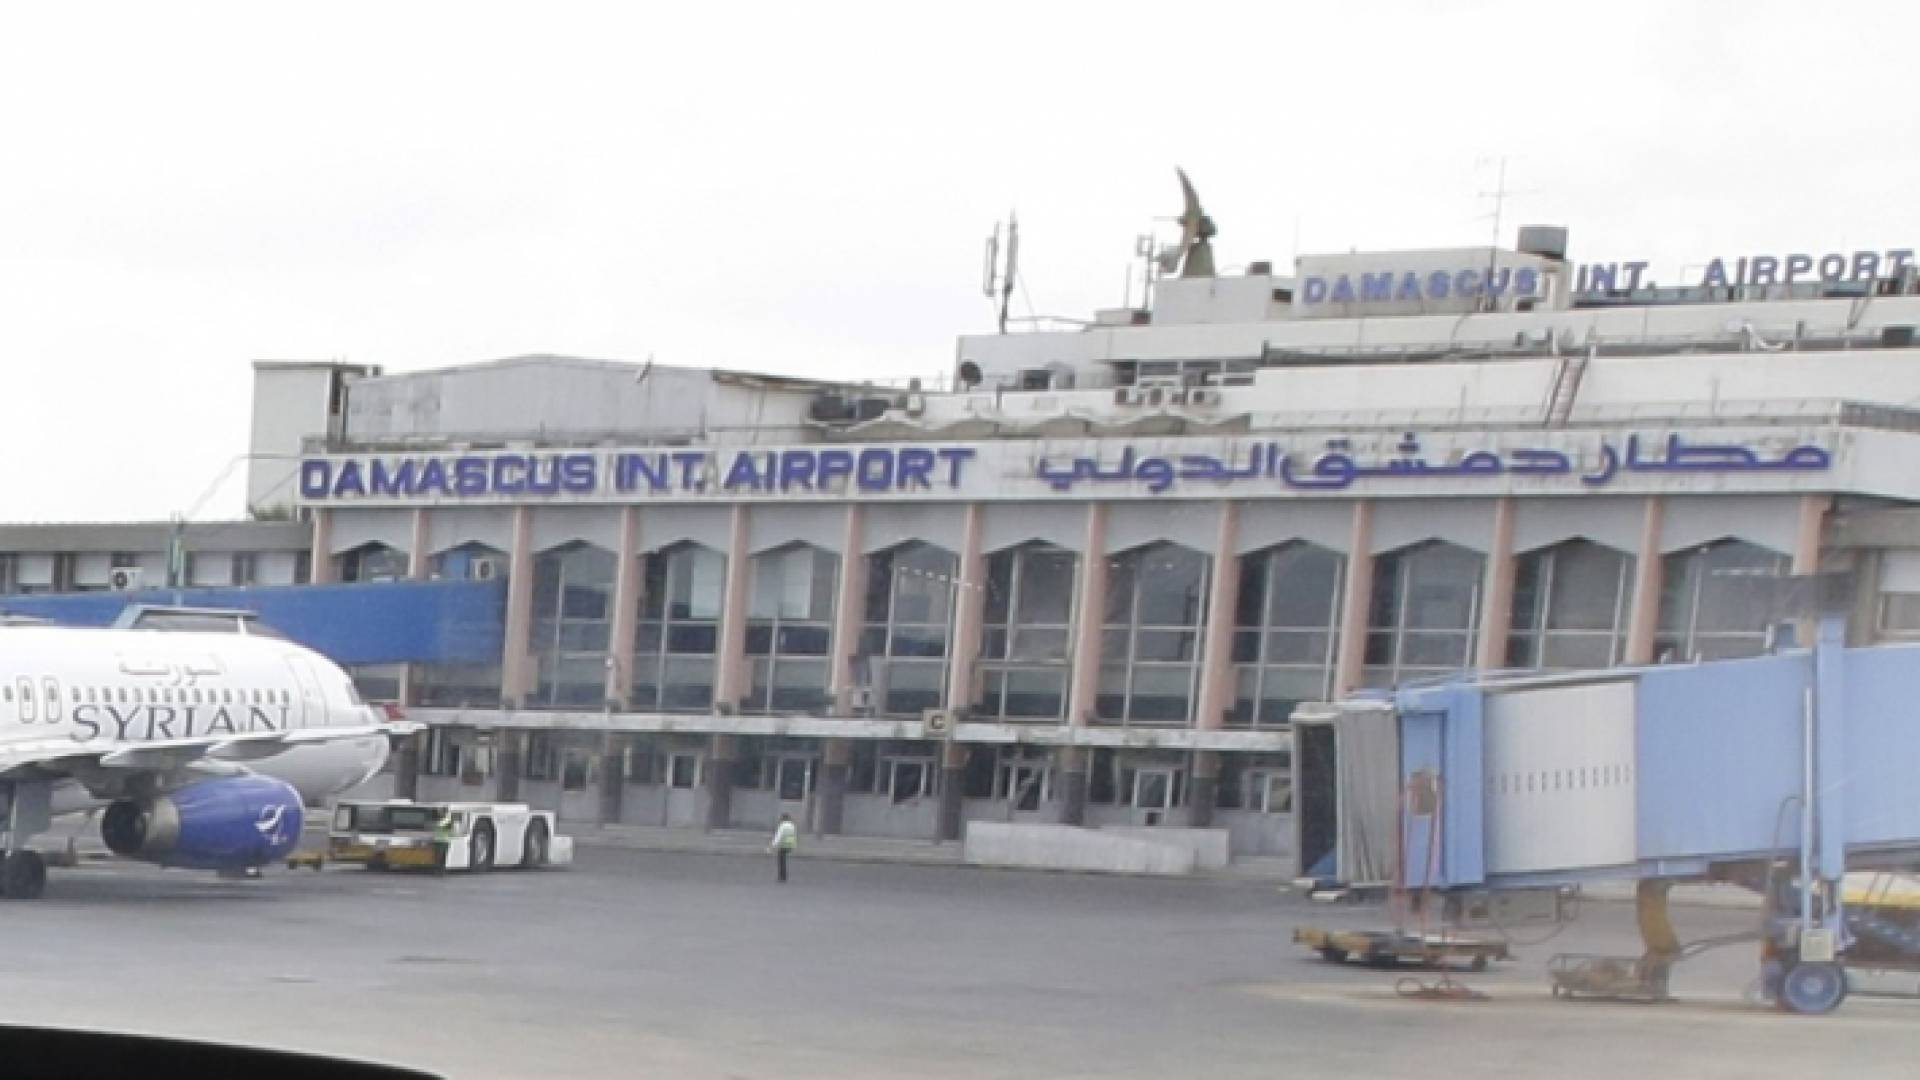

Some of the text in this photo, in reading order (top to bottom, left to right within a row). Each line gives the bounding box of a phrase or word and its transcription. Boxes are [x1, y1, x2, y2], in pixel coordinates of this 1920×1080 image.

[1304, 248, 1914, 304] DAMASCUS INT. AIRPORT
[301, 448, 976, 498] DAMASCUS INT. AIRPORT
[1037, 432, 1830, 492] مطار دمشق الدولي
[70, 704, 289, 742] SYRIAN
